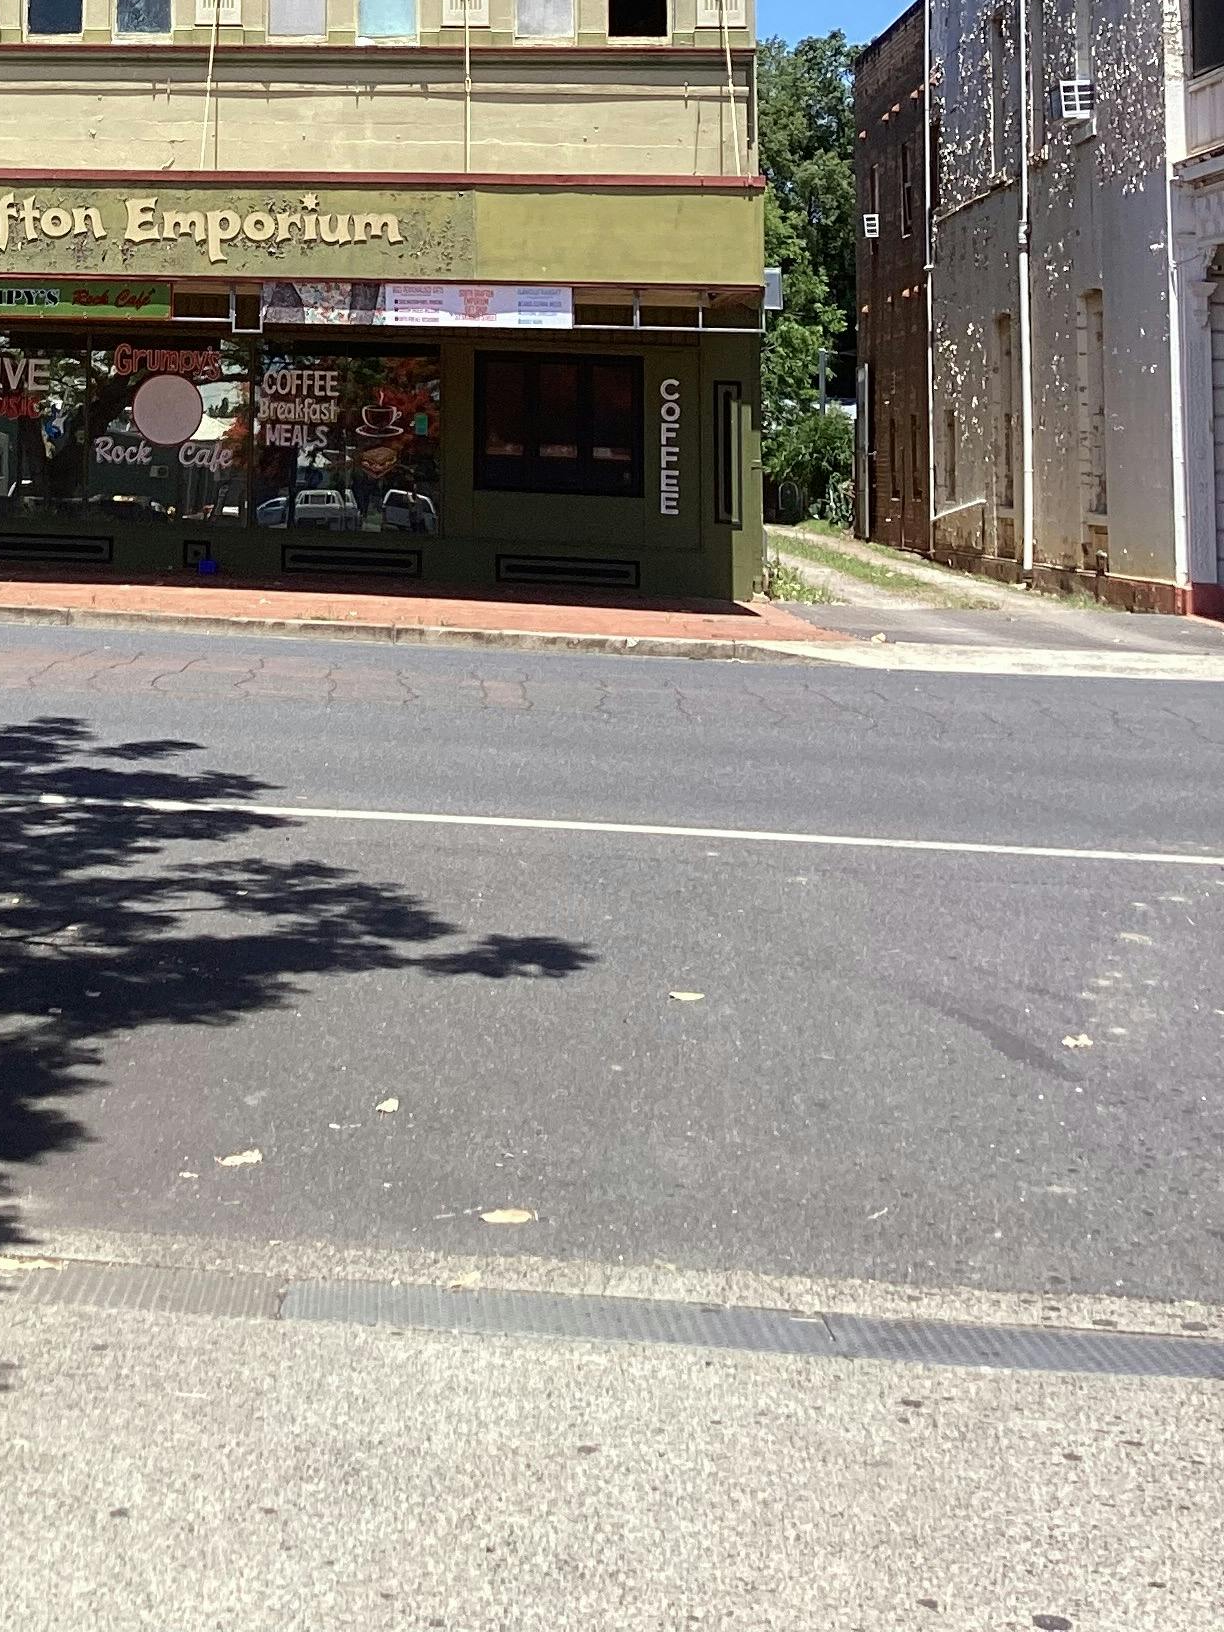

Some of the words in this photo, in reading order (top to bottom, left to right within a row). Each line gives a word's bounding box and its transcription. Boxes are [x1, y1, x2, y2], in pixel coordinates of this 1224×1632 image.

[124, 192, 405, 264] Emporium
[113, 342, 222, 381] Grumpy's
[263, 369, 341, 397] COFFEE
[256, 398, 340, 424] Breakfast
[94, 435, 153, 465] Rock
[265, 424, 331, 448] MEALS
[659, 377, 682, 516] COFFEE
